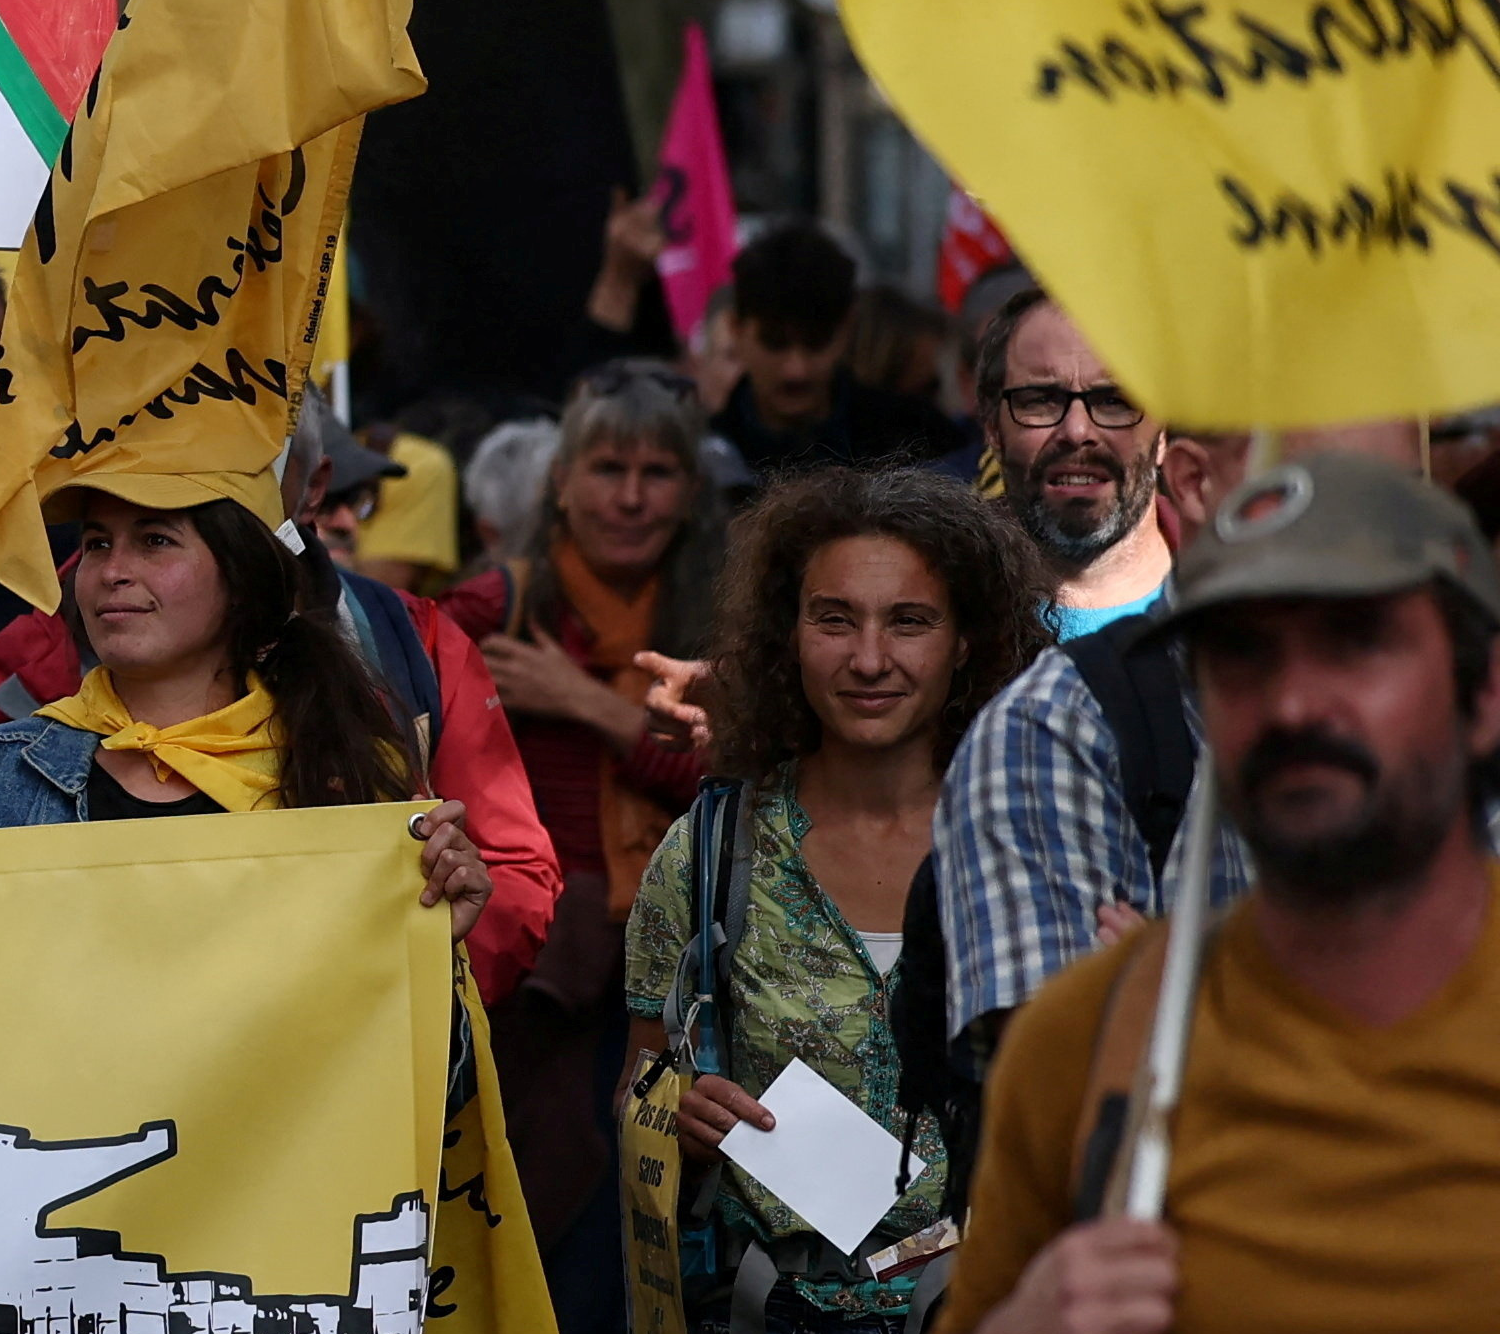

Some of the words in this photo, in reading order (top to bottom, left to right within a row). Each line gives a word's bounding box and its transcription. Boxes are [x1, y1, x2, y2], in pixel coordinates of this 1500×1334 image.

[325, 234, 337, 249] 19
[319, 252, 333, 274] SIP
[317, 275, 328, 297] par
[303, 299, 322, 344] Réalisé
[633, 1097, 657, 1129] Pas
[652, 1102, 669, 1133] de
[638, 1155, 665, 1187] sans
